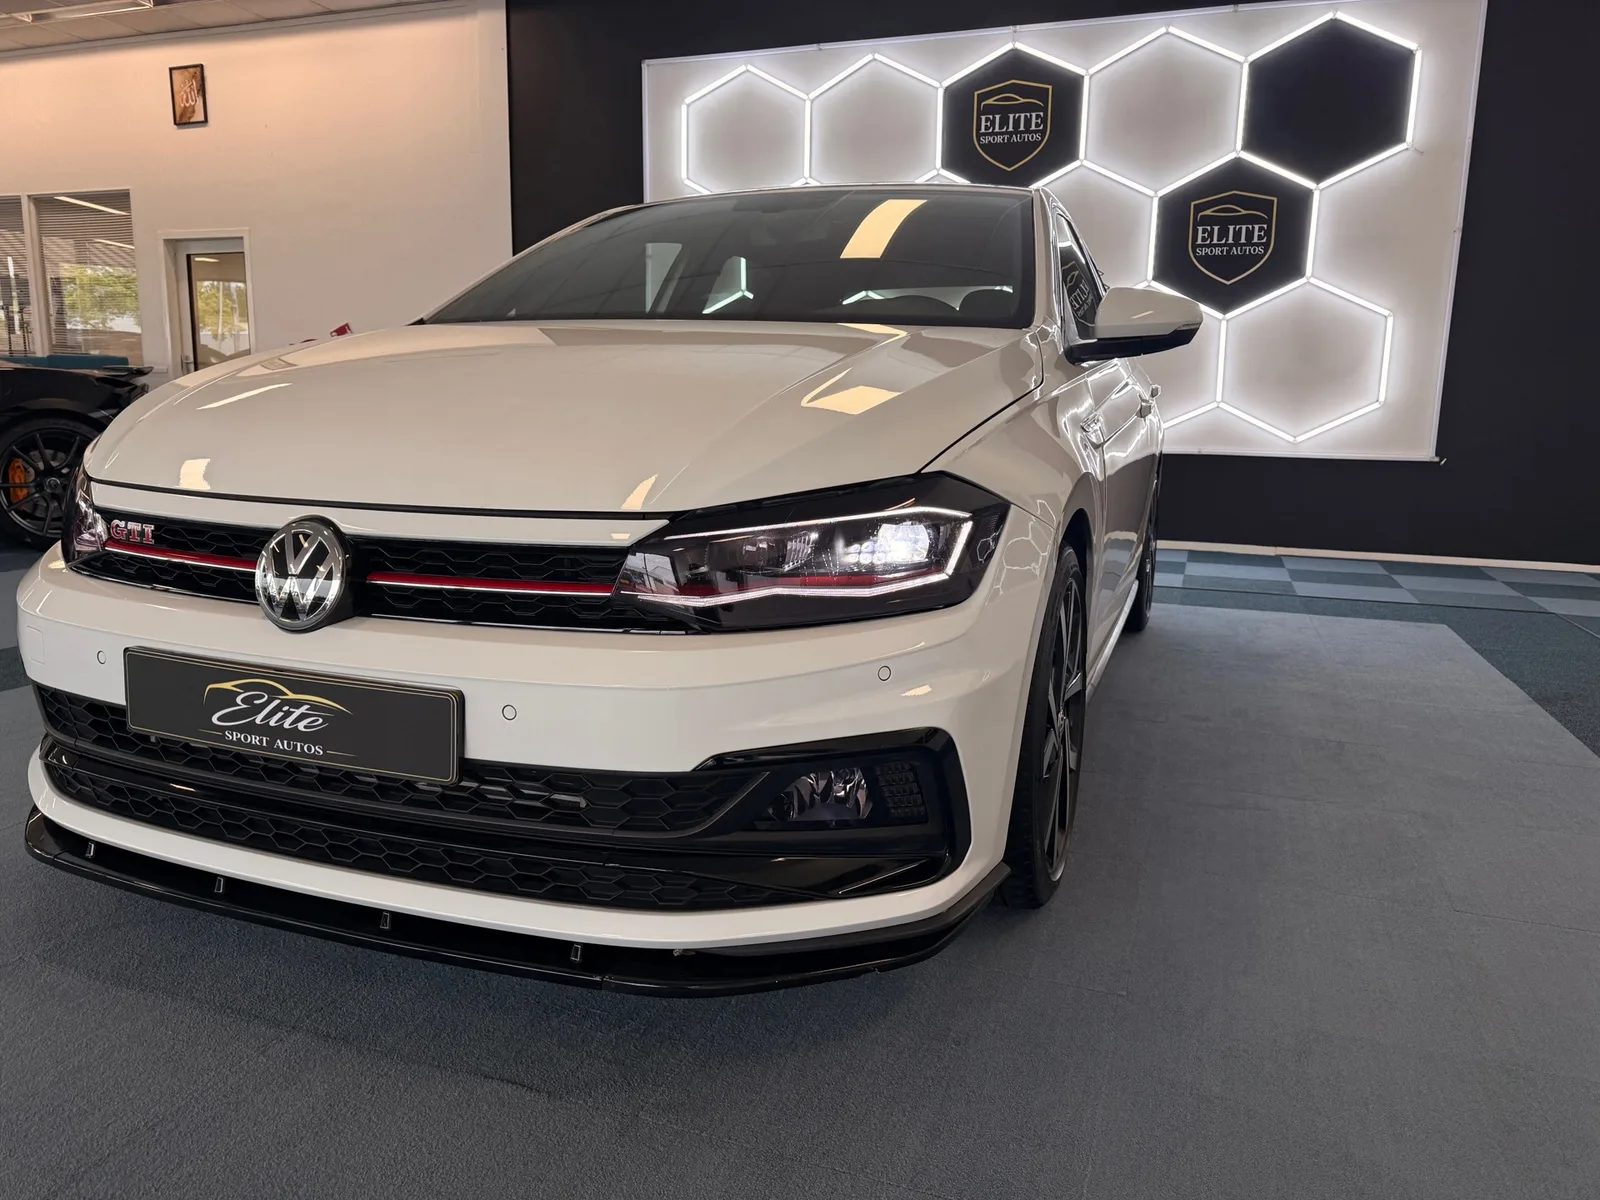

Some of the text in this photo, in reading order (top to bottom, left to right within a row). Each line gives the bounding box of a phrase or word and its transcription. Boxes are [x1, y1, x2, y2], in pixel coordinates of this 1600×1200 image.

[979, 112, 1044, 133] ELITE
[979, 132, 1042, 144] SPORT AUTOS
[1195, 224, 1268, 245] ELITE
[1195, 245, 1265, 256] SPORT AUTOS
[110, 519, 155, 545] GTI
[211, 691, 335, 732] Elite
[224, 730, 324, 755] SPORT AUTOS
